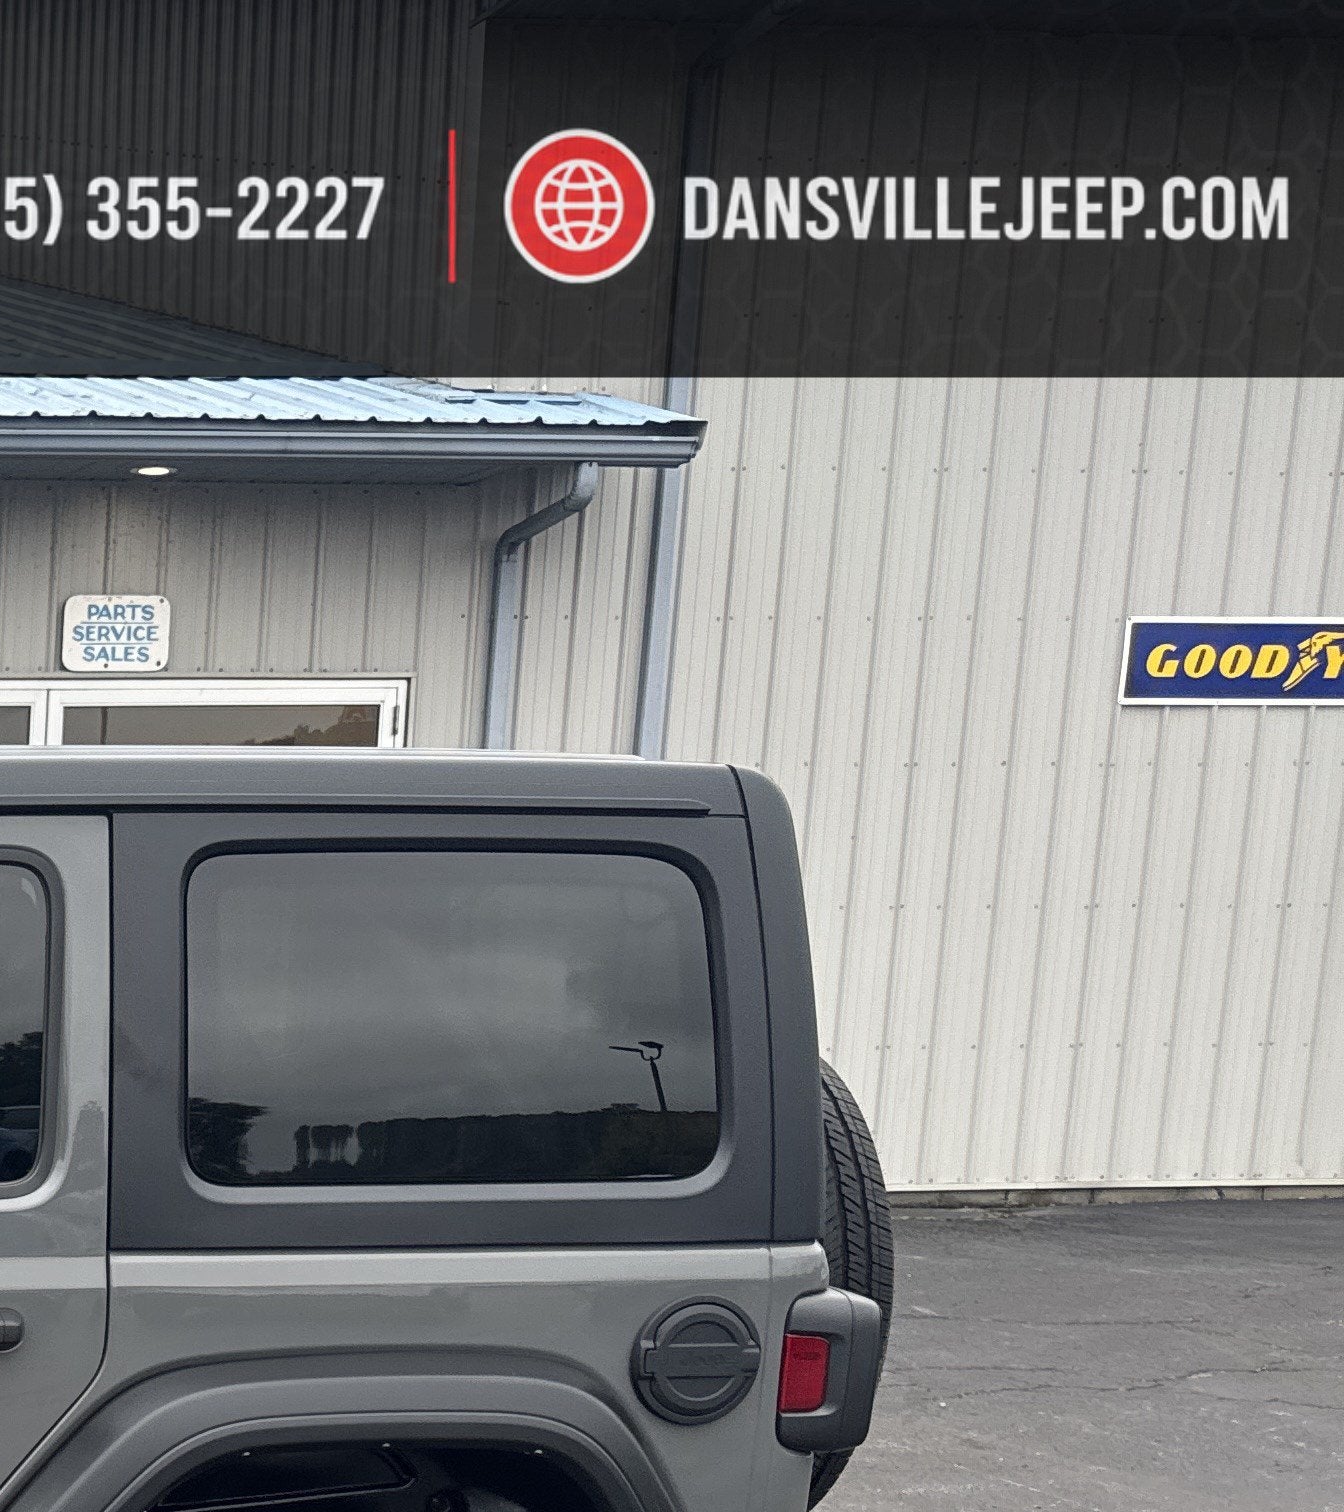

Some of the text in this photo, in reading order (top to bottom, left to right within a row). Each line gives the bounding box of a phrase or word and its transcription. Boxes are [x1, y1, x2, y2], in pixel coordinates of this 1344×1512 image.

[87, 604, 155, 621] PARTS
[72, 625, 159, 641] SERVICE
[82, 646, 150, 662] SALES
